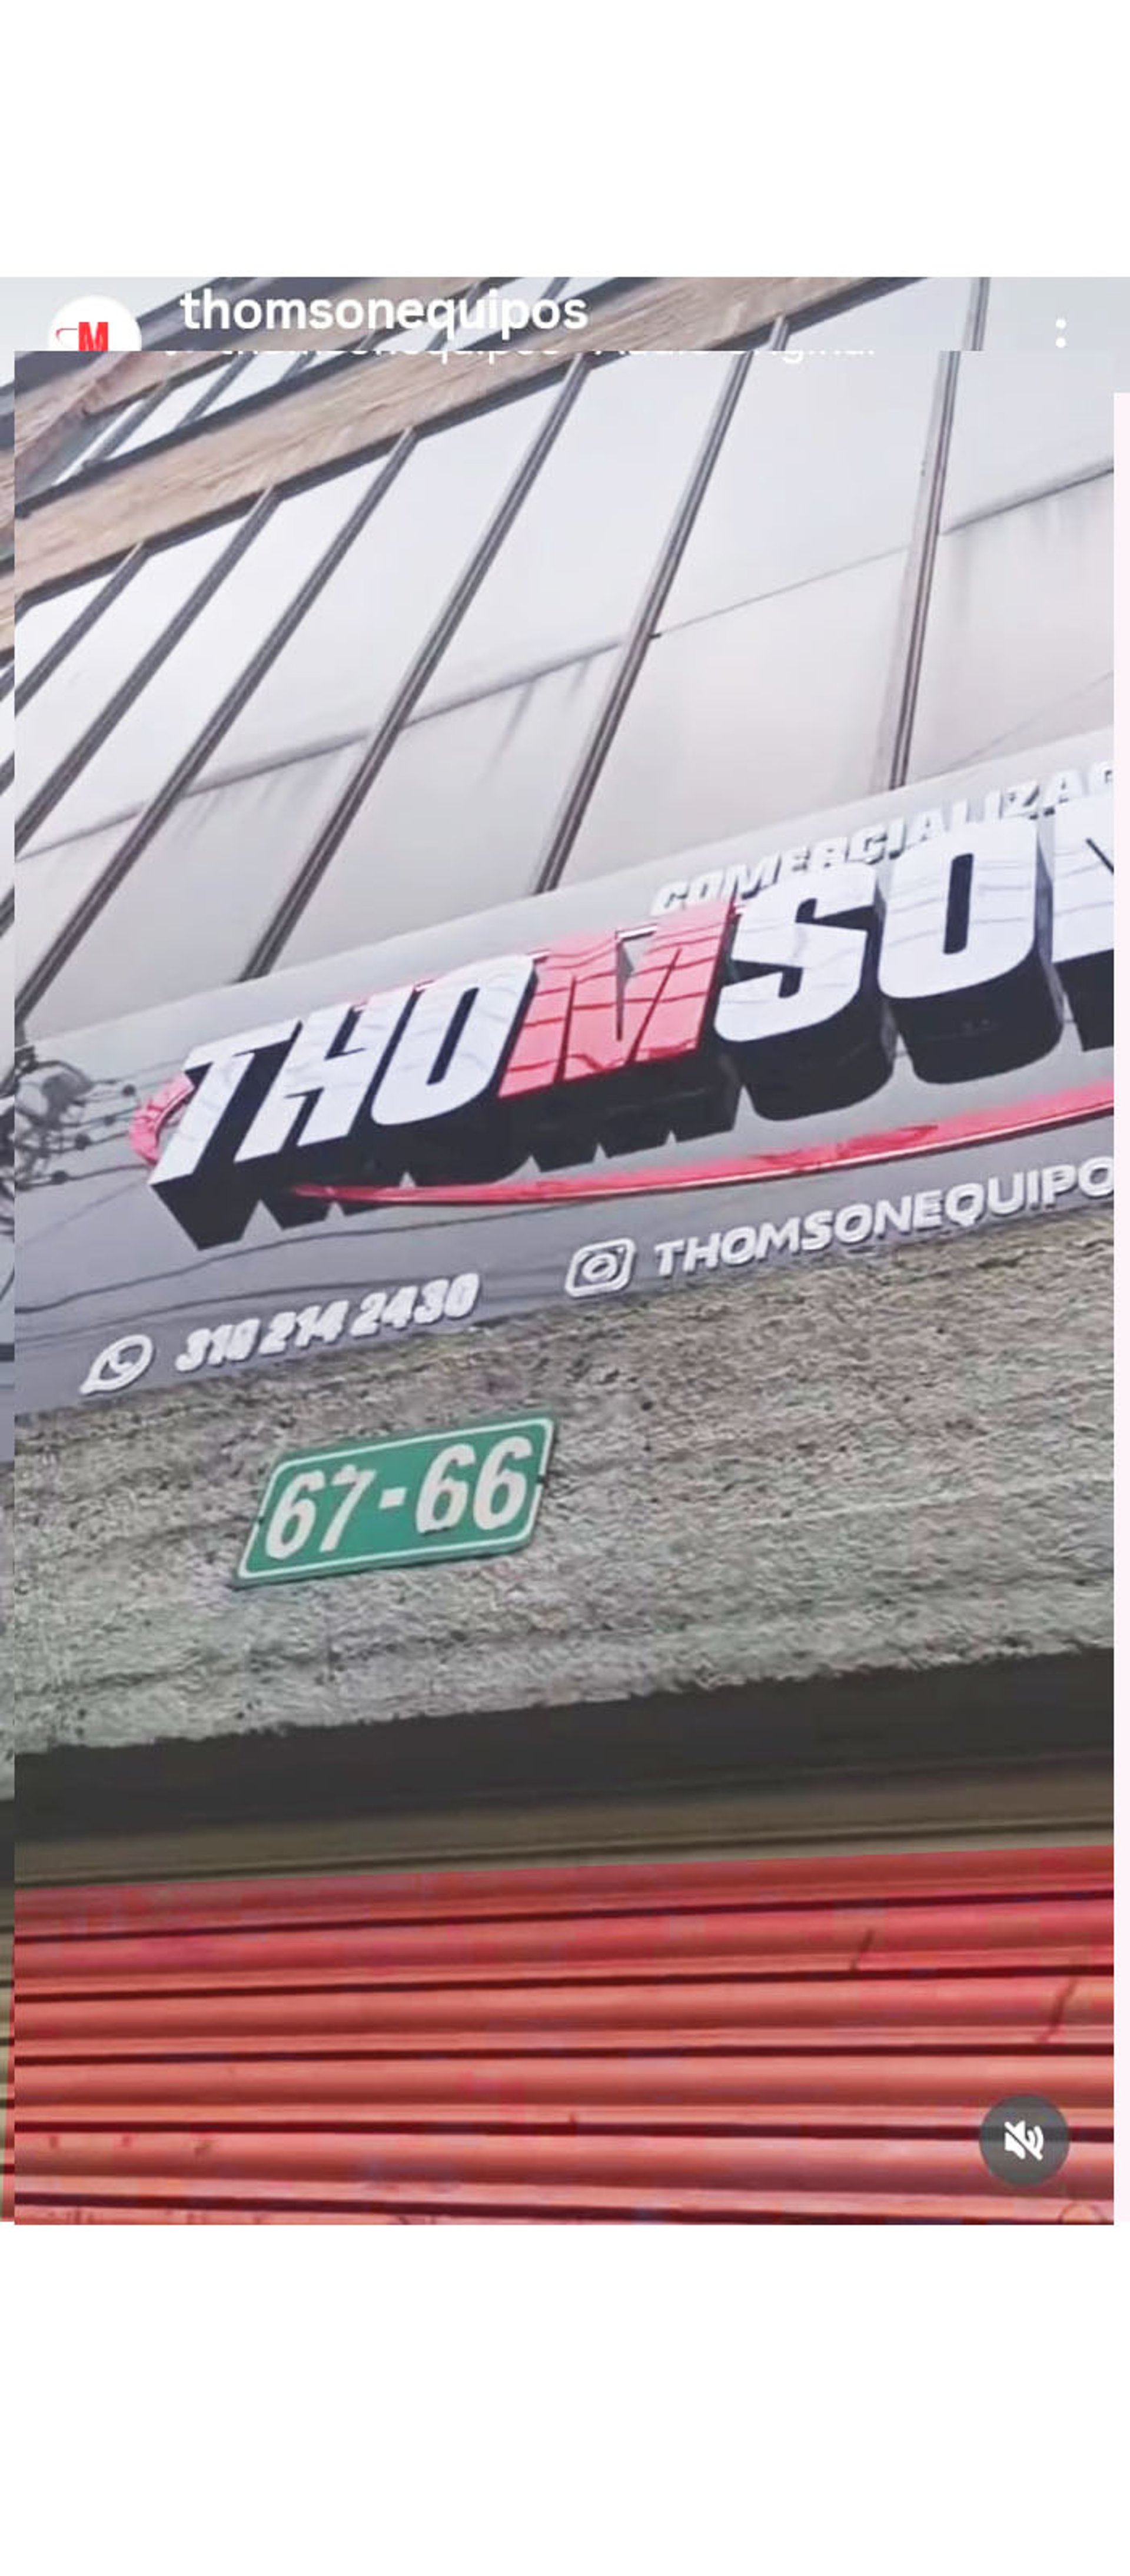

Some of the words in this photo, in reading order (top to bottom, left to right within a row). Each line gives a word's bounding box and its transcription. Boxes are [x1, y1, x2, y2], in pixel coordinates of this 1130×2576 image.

[175, 1318, 260, 1372] 310
[258, 1300, 350, 1356] 214
[350, 1273, 480, 1336] 2430
[265, 1436, 533, 1559] 67-66
